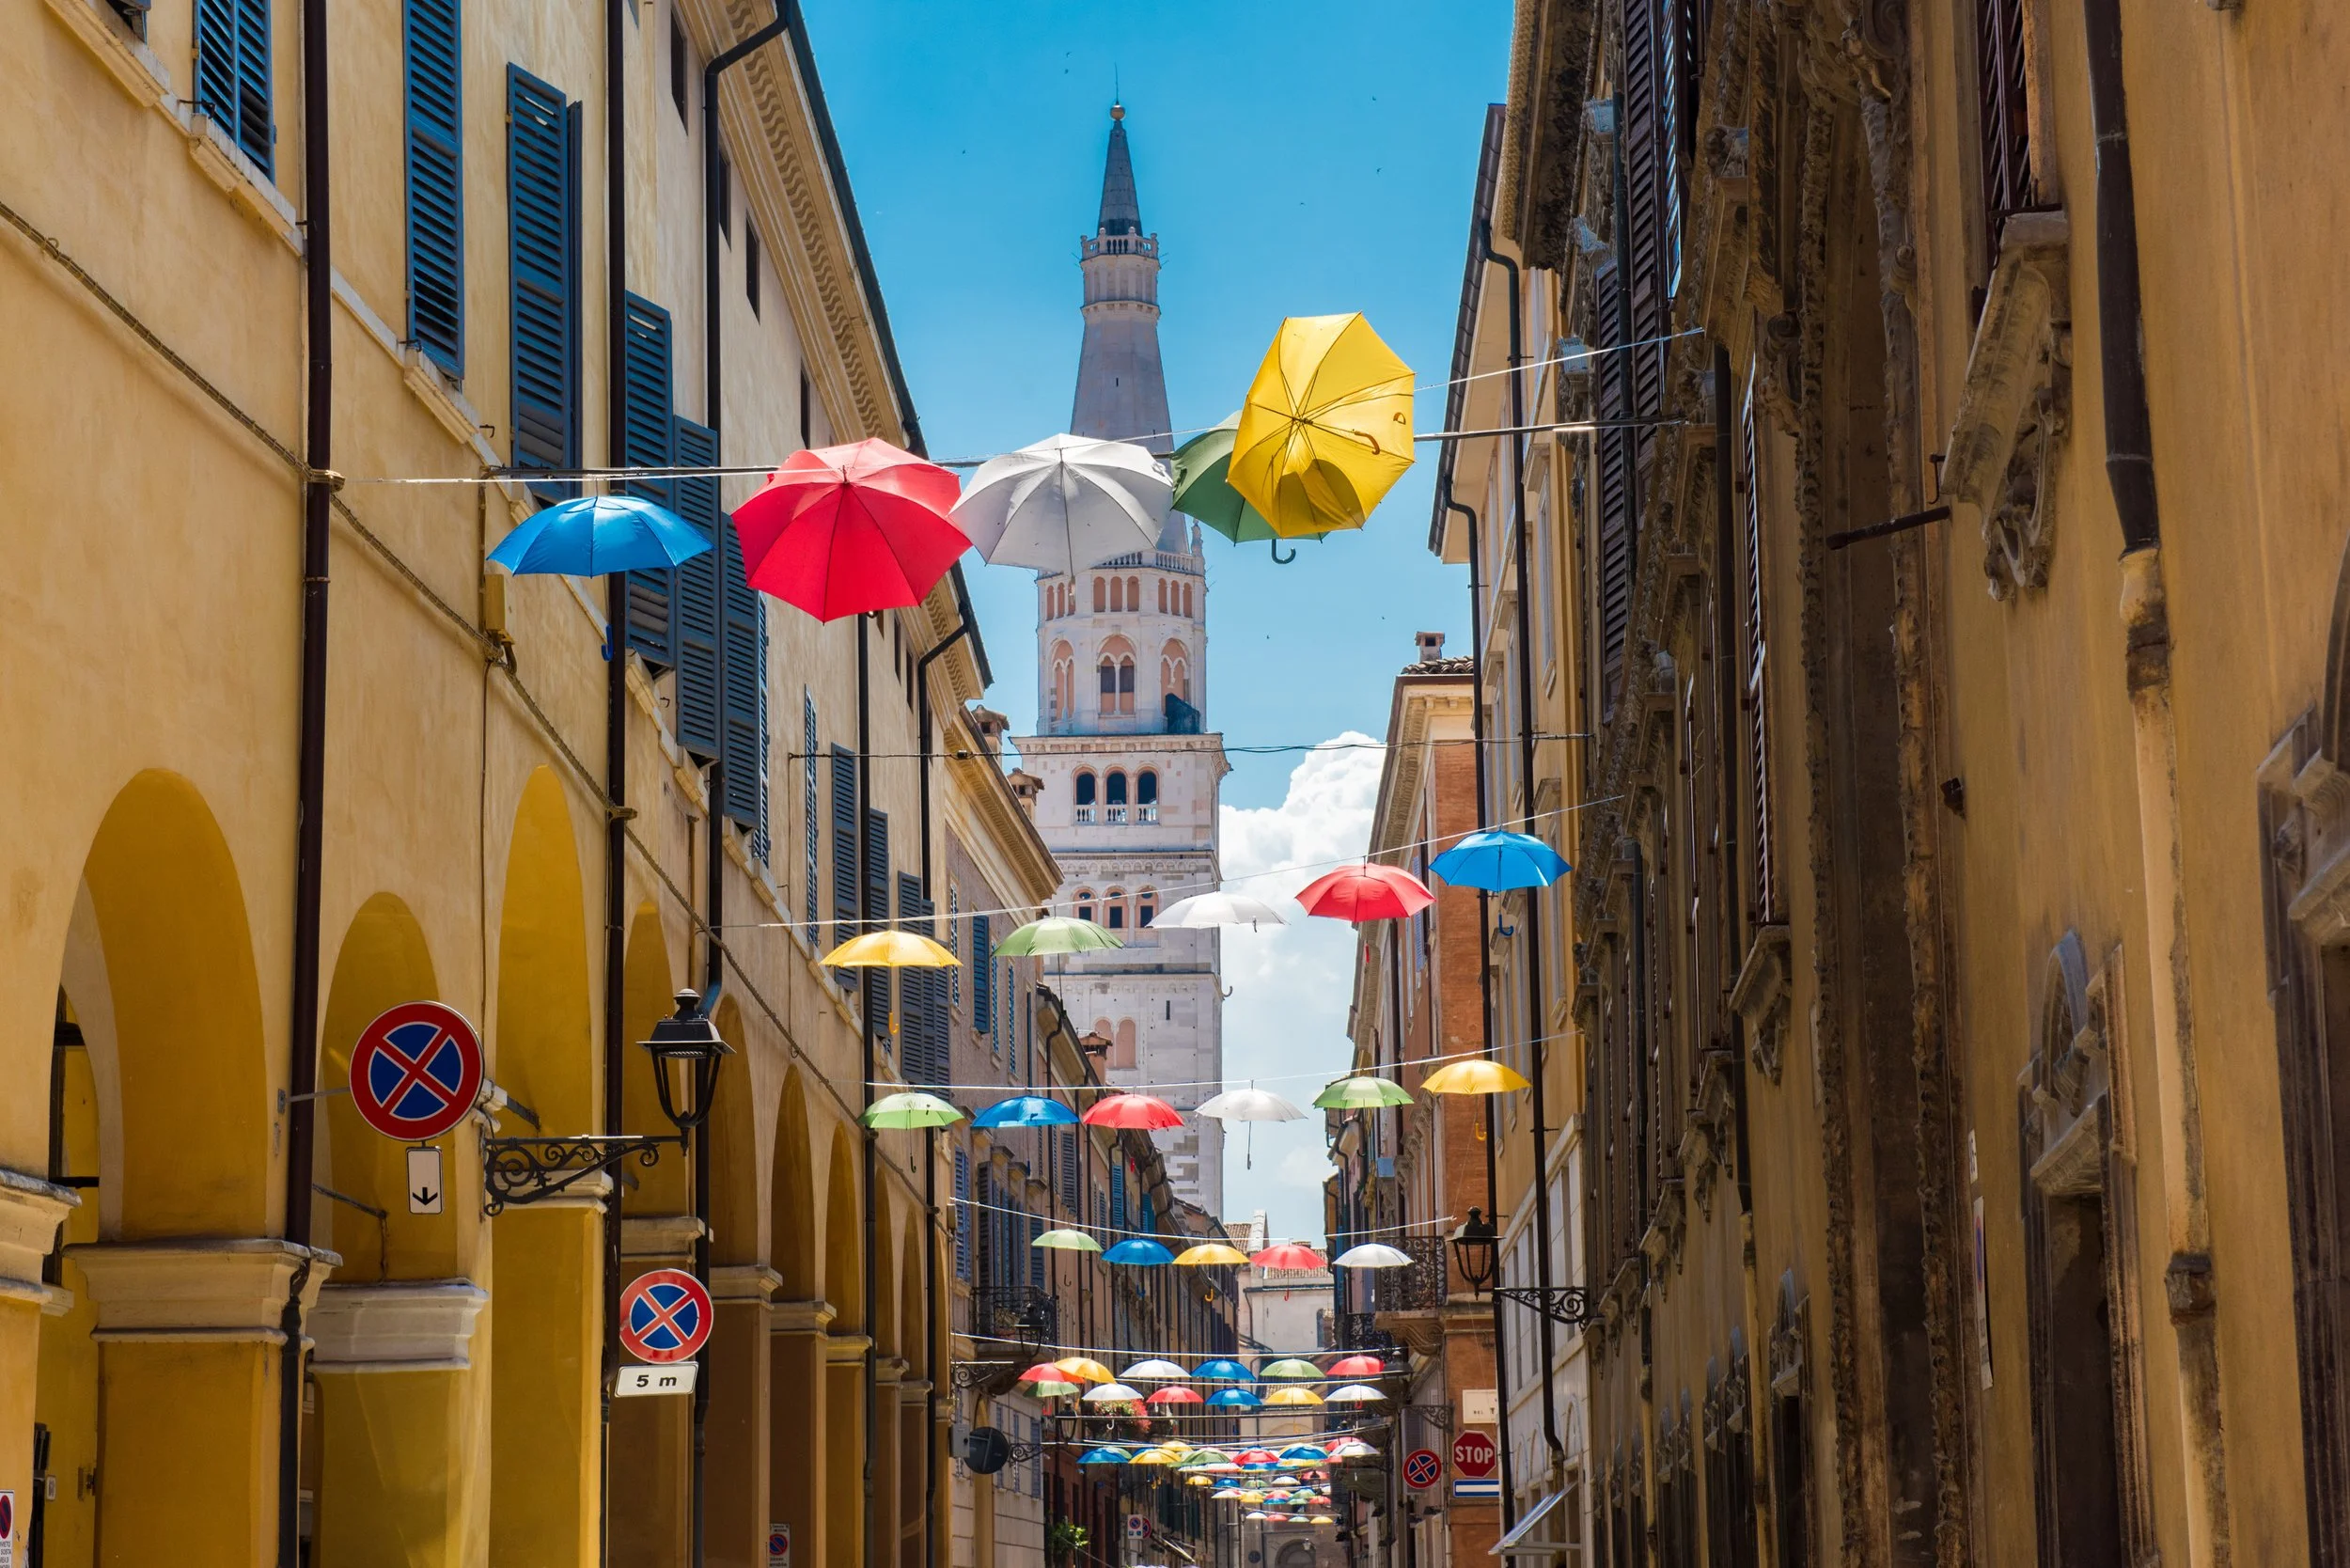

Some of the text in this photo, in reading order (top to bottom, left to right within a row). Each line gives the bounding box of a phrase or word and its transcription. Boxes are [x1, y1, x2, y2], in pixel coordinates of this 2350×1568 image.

[635, 1374, 677, 1388] 5 m
[1455, 1446, 1494, 1465] STOP
